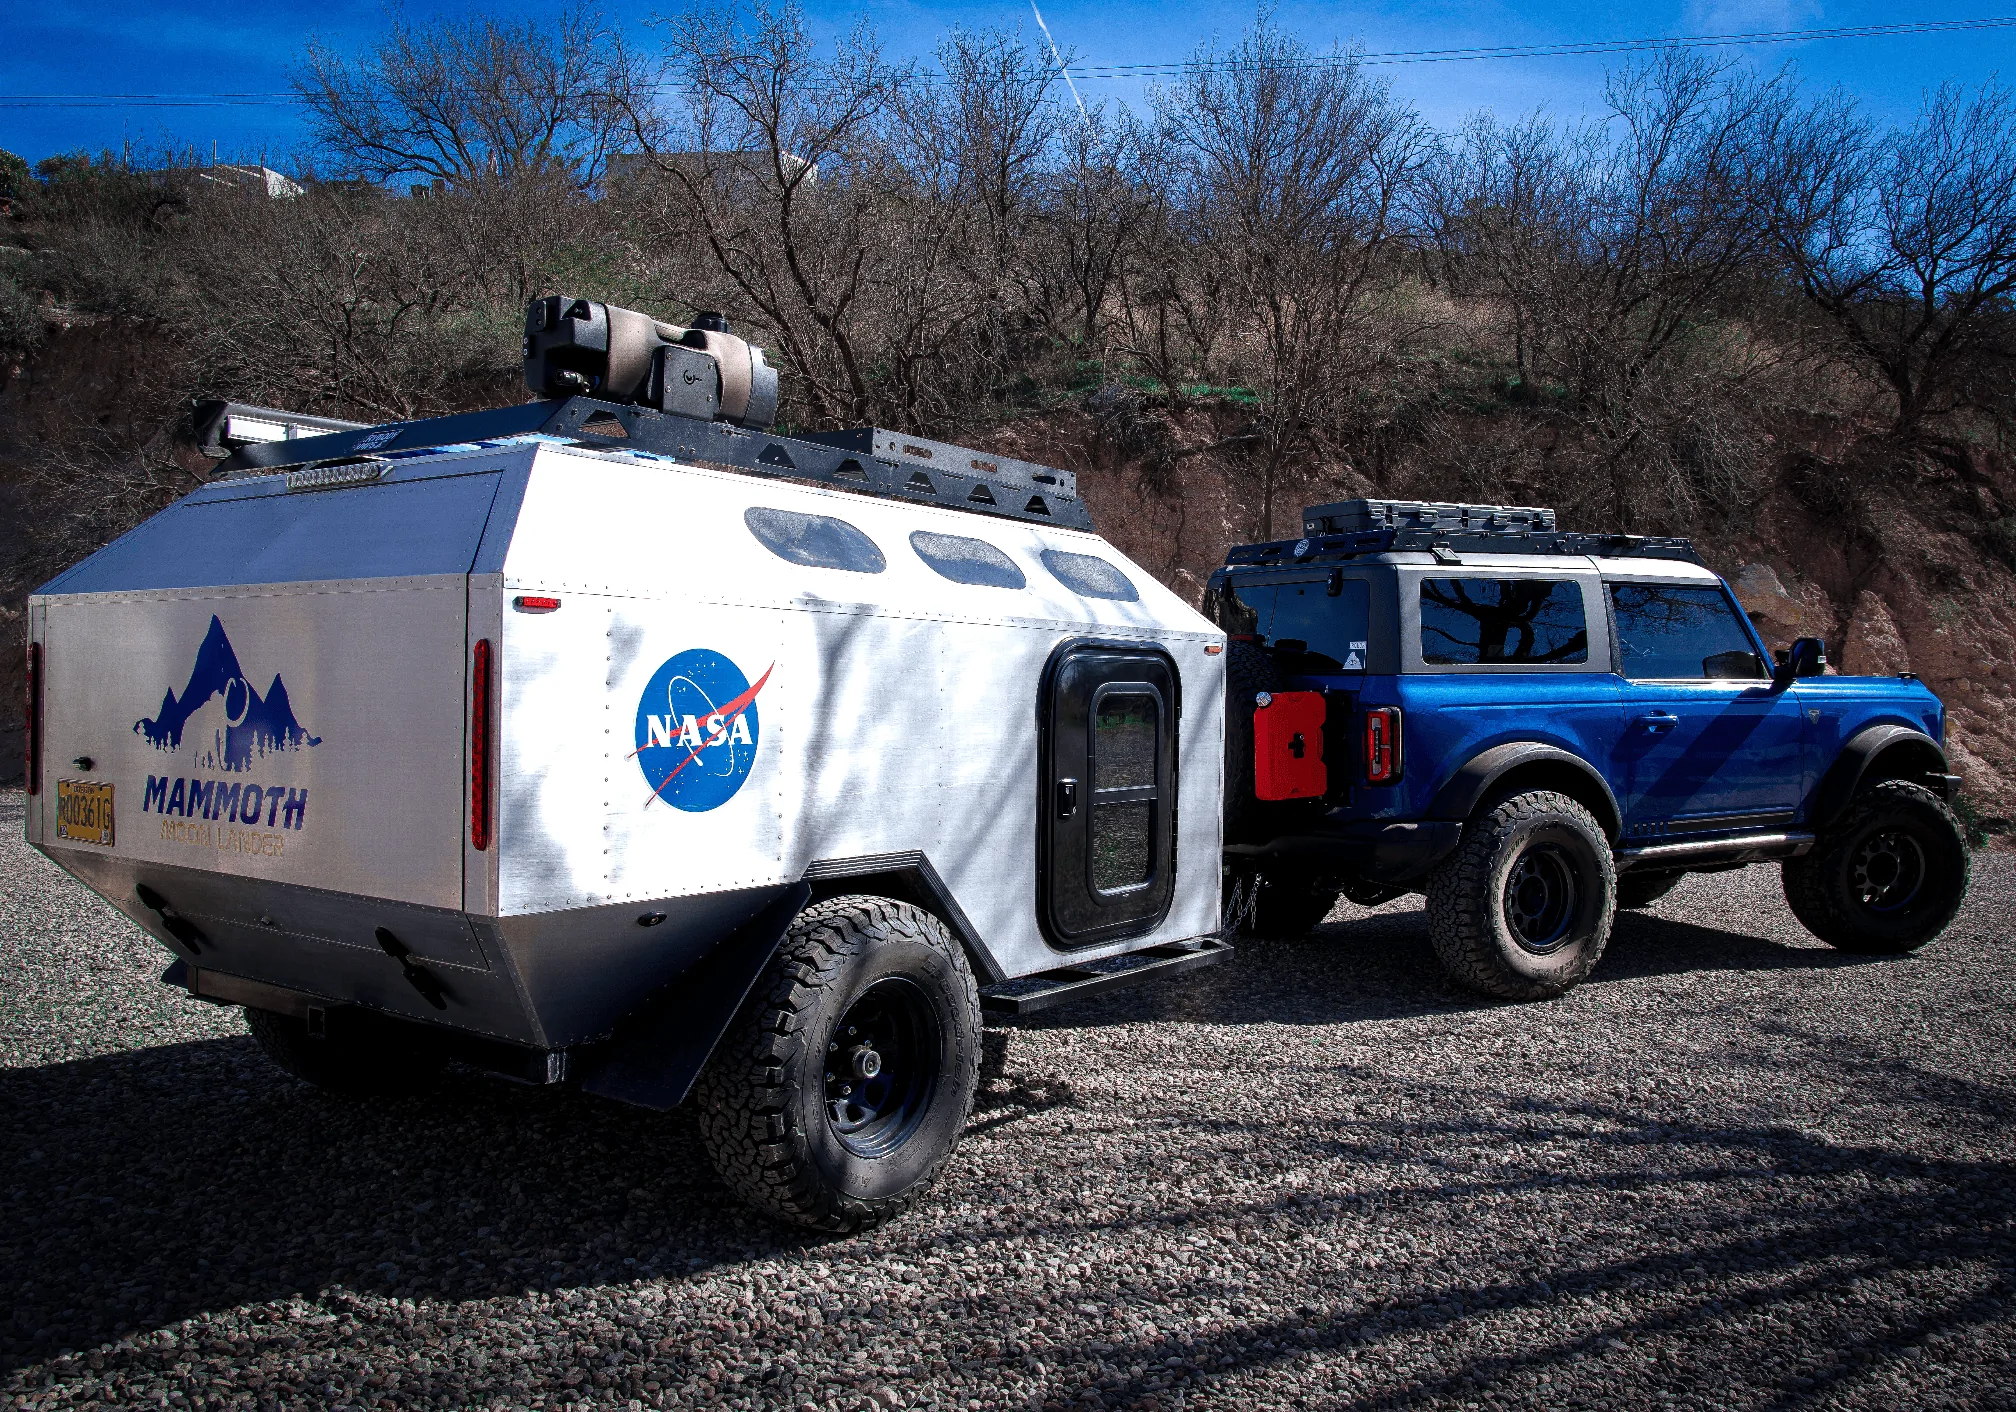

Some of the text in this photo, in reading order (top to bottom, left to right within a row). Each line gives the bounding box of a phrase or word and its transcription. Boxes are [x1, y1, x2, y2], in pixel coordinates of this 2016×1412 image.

[646, 713, 753, 748] NASA
[143, 774, 308, 831] MAMMOTH
[159, 819, 285, 858] MOON LANDER
